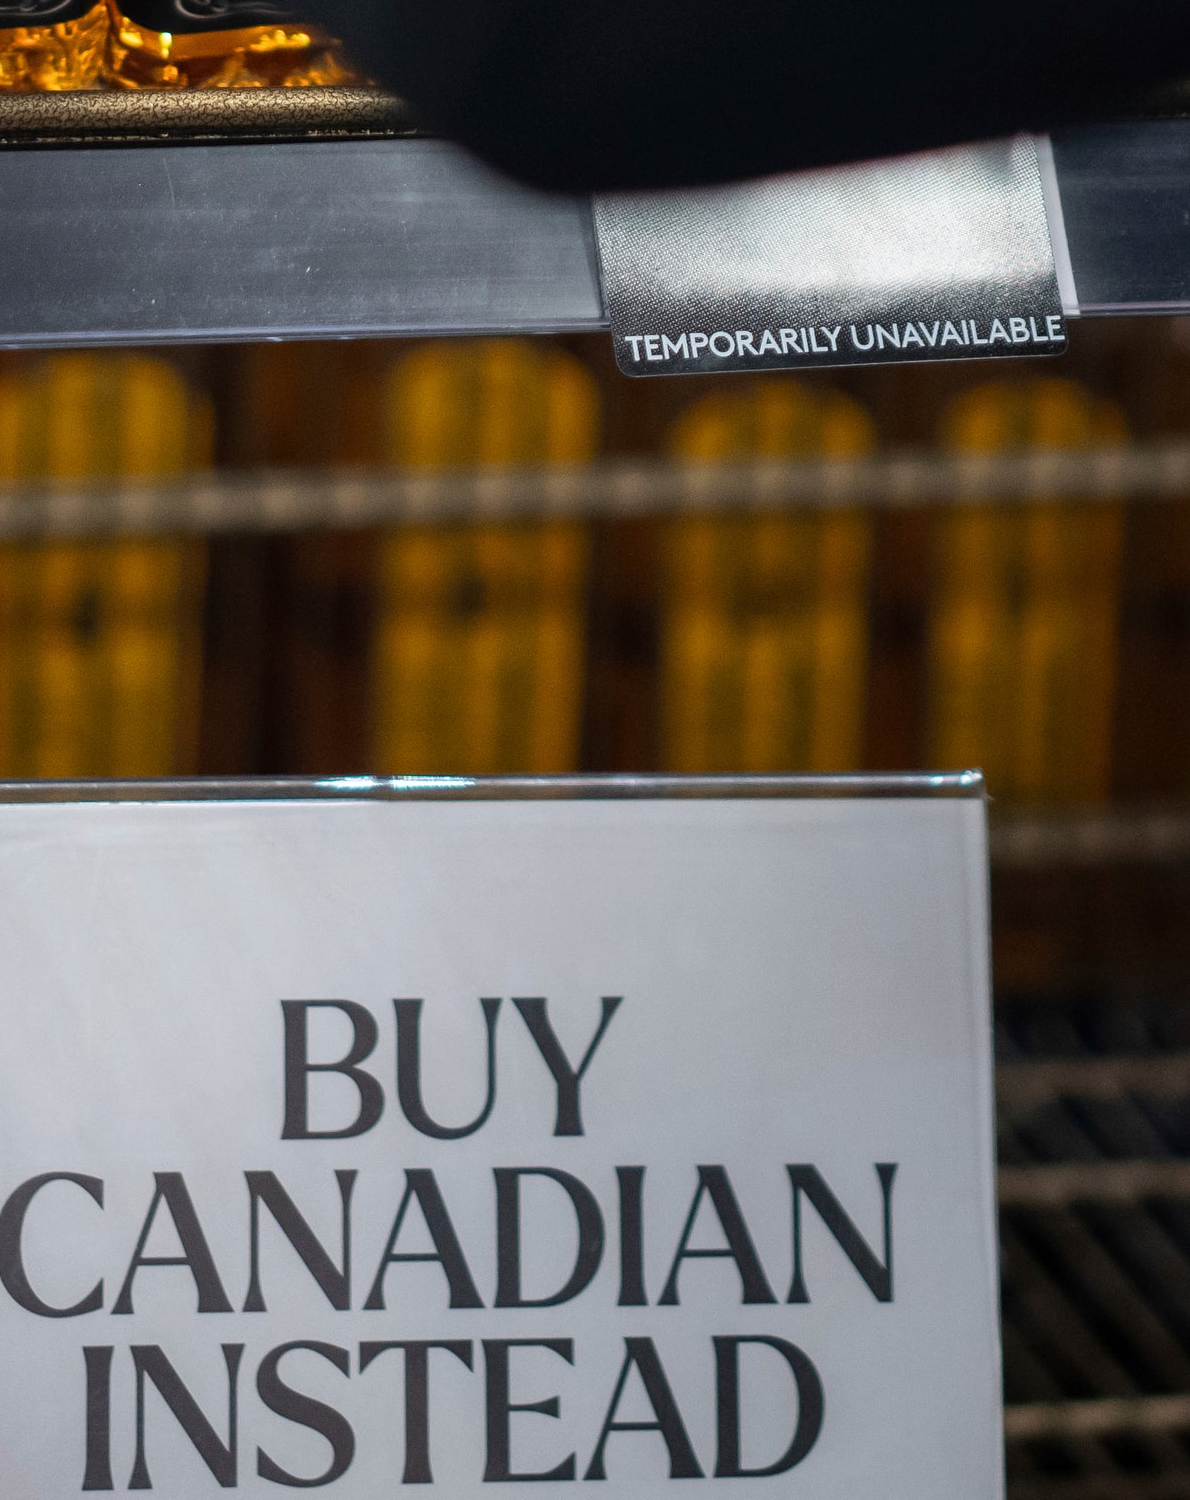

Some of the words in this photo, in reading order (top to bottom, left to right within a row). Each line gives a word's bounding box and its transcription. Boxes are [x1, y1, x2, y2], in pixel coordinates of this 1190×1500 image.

[625, 325, 841, 362] TEMPORARILY
[852, 315, 1066, 352] UNAVAILABLE
[280, 996, 624, 1141] BUY
[81, 1335, 826, 1491] INSTEAD
